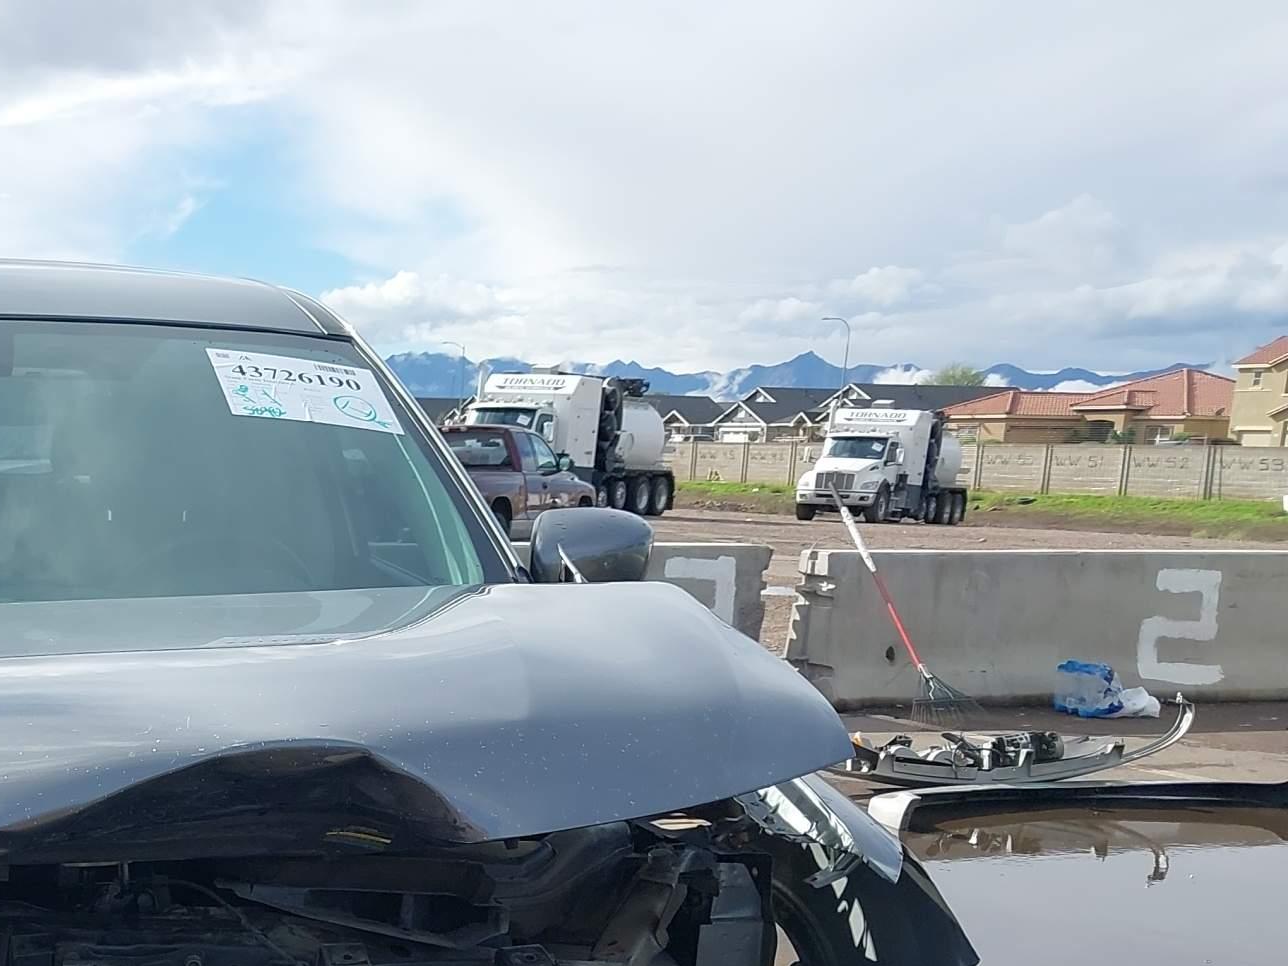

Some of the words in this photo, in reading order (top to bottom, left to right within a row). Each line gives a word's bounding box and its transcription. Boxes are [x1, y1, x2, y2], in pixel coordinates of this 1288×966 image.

[231, 364, 361, 391] 43726190
[503, 377, 566, 385] TORNADO
[849, 411, 907, 419] TORNADO
[1137, 568, 1224, 685] 2
